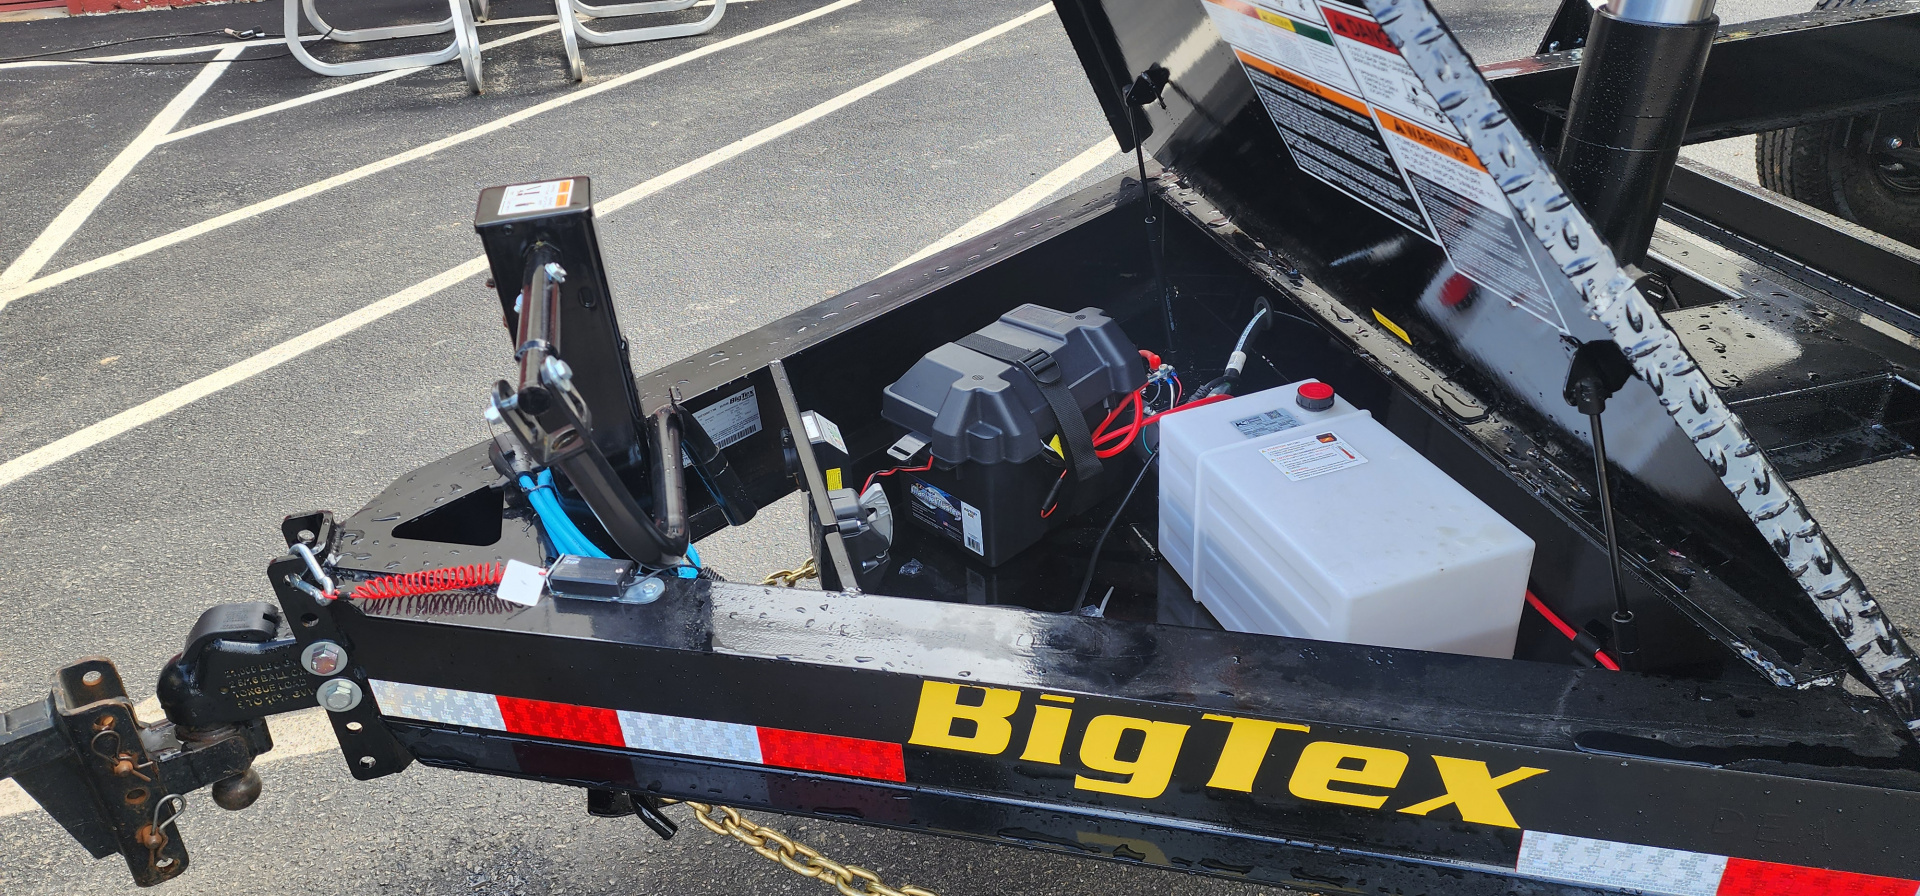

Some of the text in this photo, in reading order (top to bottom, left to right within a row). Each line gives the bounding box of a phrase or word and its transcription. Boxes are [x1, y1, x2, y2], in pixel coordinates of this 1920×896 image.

[1344, 18, 1394, 48] DANG
[1402, 123, 1470, 162] WARNING
[730, 390, 754, 404] BigTex
[229, 680, 236, 688] 2
[260, 672, 289, 682] BALL
[233, 678, 306, 698] TONGUE LOAD
[907, 679, 1549, 829] BigTex
